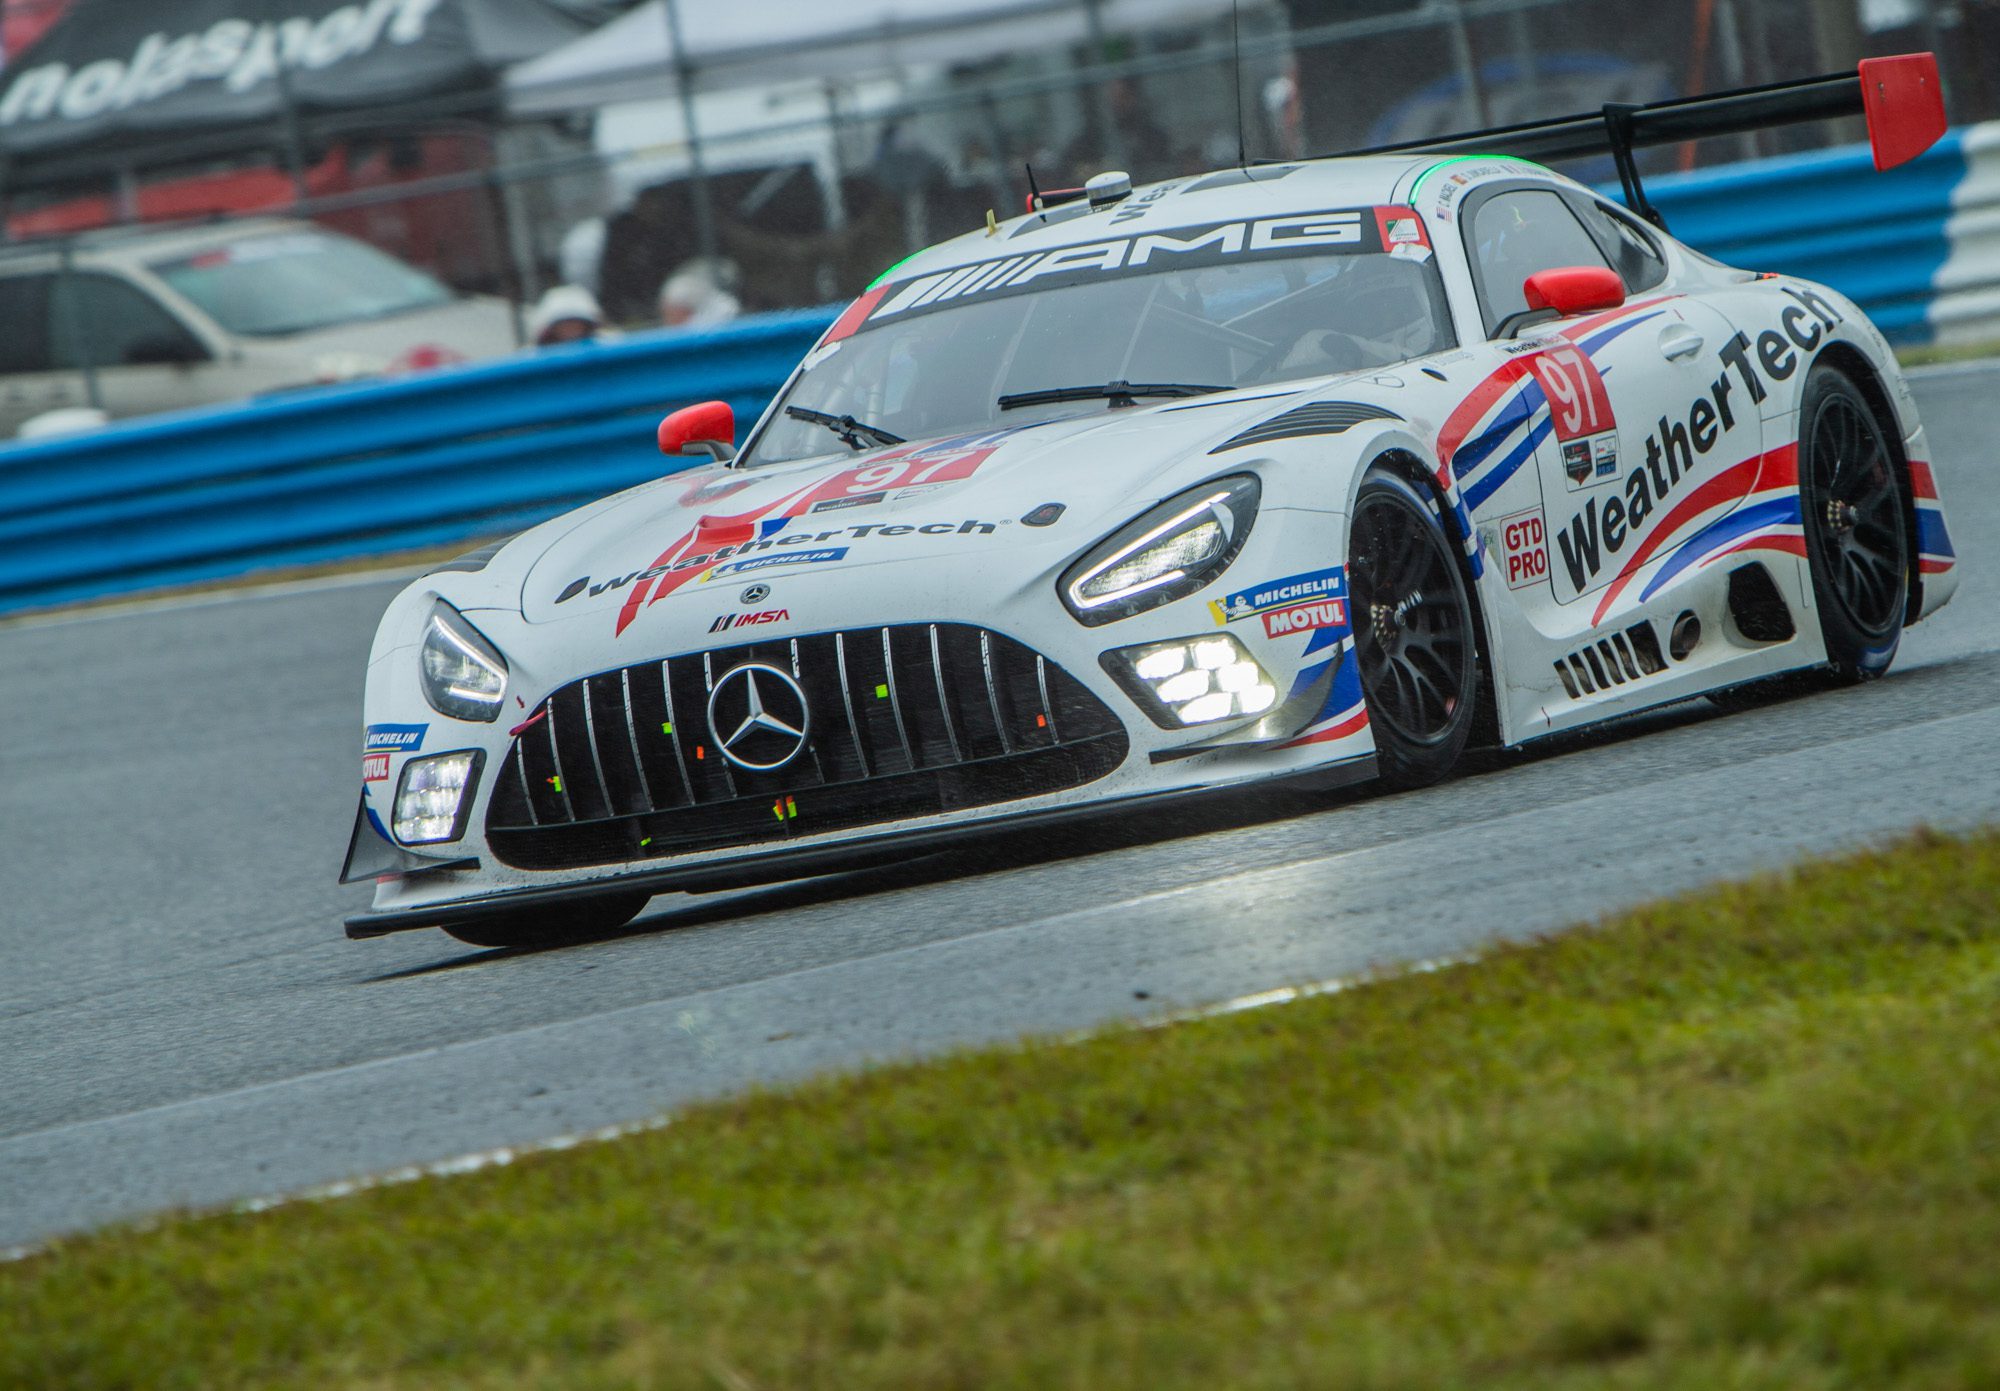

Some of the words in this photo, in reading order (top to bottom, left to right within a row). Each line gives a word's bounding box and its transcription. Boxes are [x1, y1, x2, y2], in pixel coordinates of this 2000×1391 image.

[1006, 212, 1362, 287] AMG
[1535, 349, 1599, 433] 97
[1557, 286, 1844, 594] WeatherTech
[847, 451, 977, 493] 97
[1505, 517, 1543, 551] GTD
[741, 551, 834, 571] MICHELIN
[1508, 547, 1546, 582] PRO
[1255, 577, 1339, 606] MICHELIN
[734, 609, 790, 629] IMSA
[1269, 602, 1344, 635] MOTUL
[367, 732, 420, 745] MICHELIN
